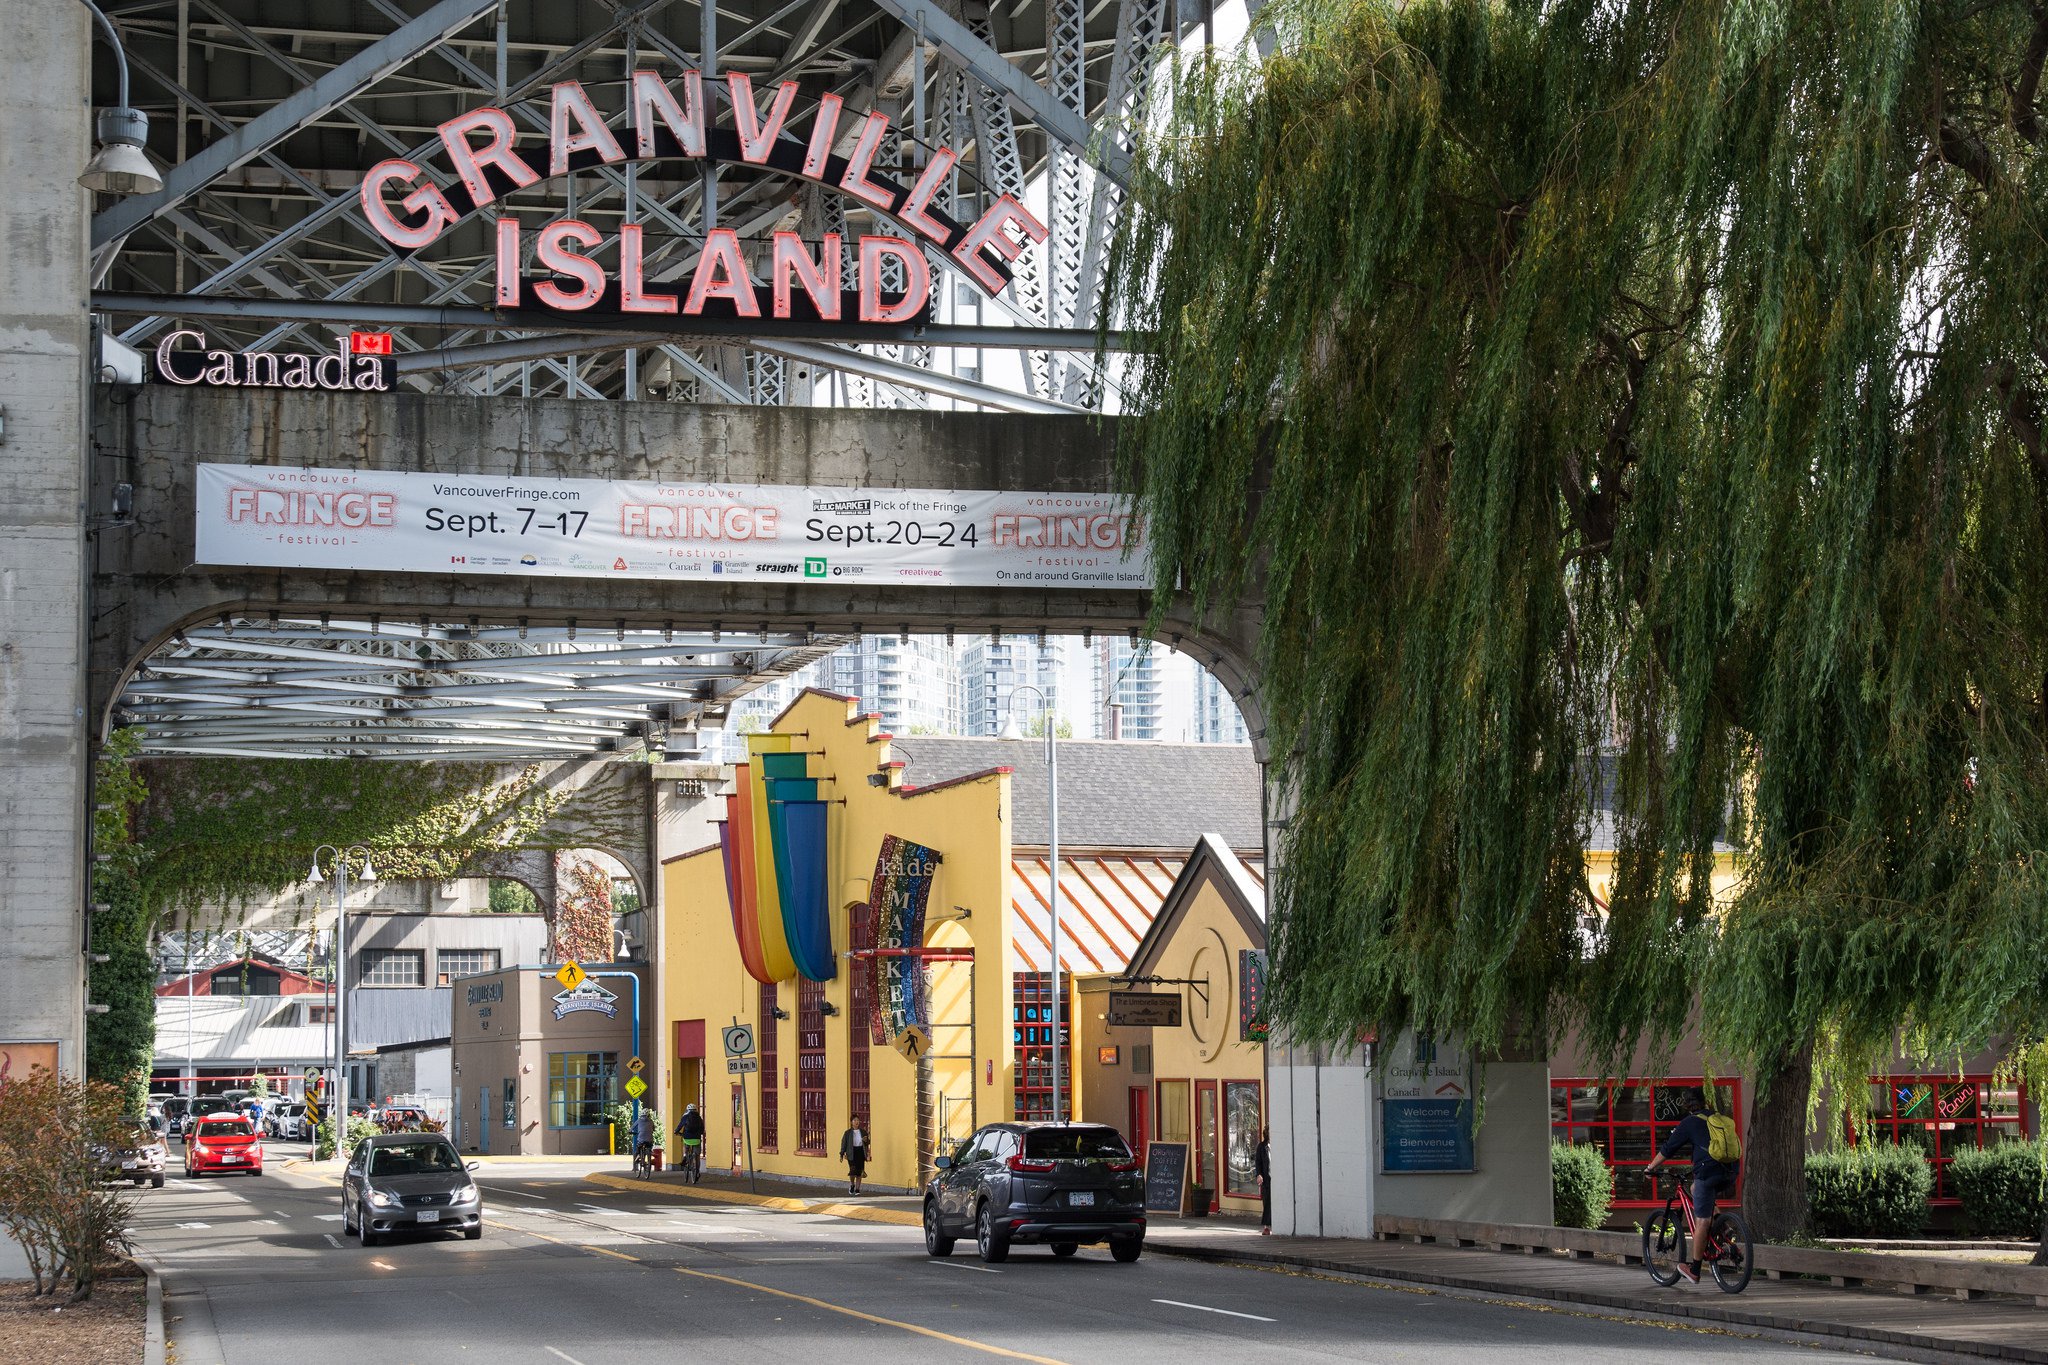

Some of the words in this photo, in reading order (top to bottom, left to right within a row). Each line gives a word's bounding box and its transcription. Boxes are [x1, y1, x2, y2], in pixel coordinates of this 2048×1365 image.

[360, 69, 1050, 297] GRANVILLE
[495, 217, 931, 323] ISLAND
[157, 330, 391, 391] Canada
[267, 471, 358, 485] vancouver
[433, 484, 580, 502] VancouverFringe.com
[657, 487, 743, 499] vancouver
[229, 488, 395, 528] FRINGE
[873, 500, 896, 511] Pick
[899, 501, 911, 511] of
[912, 501, 930, 511] the
[933, 502, 967, 514] Fringe
[1027, 498, 1108, 508] vancouver
[425, 507, 506, 538] Sept.
[622, 503, 778, 542] FRINGE
[993, 514, 1139, 550] FRING
[668, 561, 701, 571] Canada
[755, 563, 799, 574] straight
[806, 560, 825, 574] TD
[996, 570, 1011, 580] On
[1014, 571, 1032, 580] and
[1034, 571, 1069, 580] around
[1071, 572, 1114, 581] Granville
[1116, 572, 1145, 581] Island
[879, 857, 935, 877] kids
[886, 889, 912, 1027] MARKET
[559, 1001, 590, 1011] GRANVILLE
[591, 1001, 613, 1011] ISLAND
[1159, 999, 1178, 1007] Shop
[729, 1062, 738, 1070] 20
[740, 1061, 756, 1069] km/h
[1435, 1066, 1461, 1077] Island
[1387, 1087, 1420, 1097] Canada
[1938, 1084, 1974, 1117] Panini
[1403, 1108, 1450, 1116] Welcome
[1400, 1138, 1456, 1147] Bienvenue
